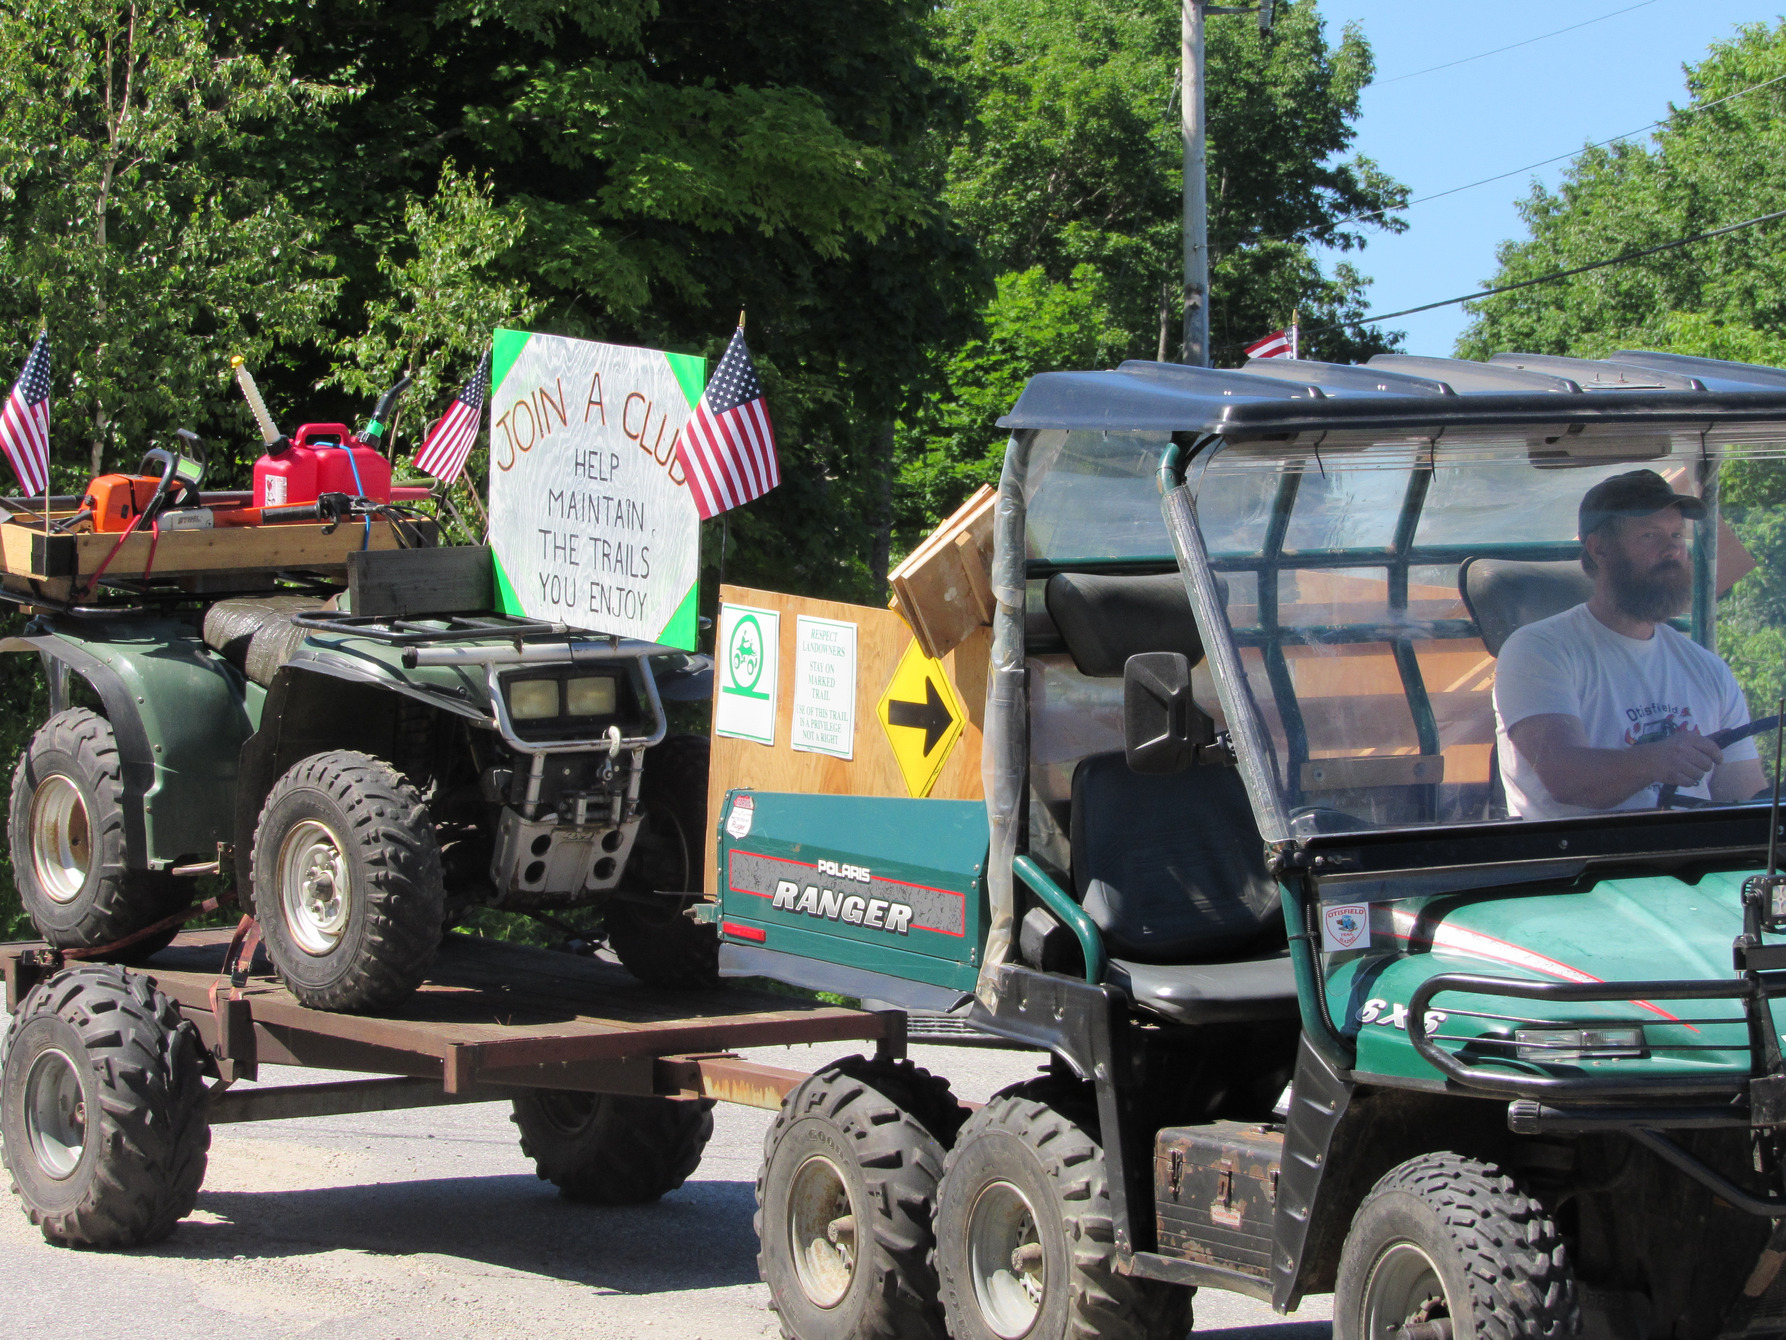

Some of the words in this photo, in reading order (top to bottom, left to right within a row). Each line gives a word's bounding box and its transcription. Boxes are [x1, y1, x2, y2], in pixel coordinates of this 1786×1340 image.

[496, 377, 568, 472] JOIN
[584, 372, 606, 426] A
[574, 448, 620, 483] HELP
[548, 488, 645, 533] MAINTAIN
[538, 529, 580, 566] THE
[589, 537, 650, 580] TRAILS
[539, 572, 577, 608] YOU
[589, 581, 647, 622] ENJOY
[810, 628, 838, 642] RESPECT
[802, 641, 845, 657] LANDOWNERS
[809, 661, 824, 673] STAY
[825, 663, 835, 674] ON
[808, 674, 835, 688] MARKED
[811, 688, 830, 701] TRAIL
[806, 706, 814, 716] OF
[815, 707, 828, 719] THIS
[829, 710, 848, 721] TRAIL
[1626, 703, 1678, 721] Otisfield
[810, 719, 842, 733] PRIVILEGE
[802, 730, 815, 741] NOT
[820, 733, 839, 744] RIGHT
[817, 859, 871, 883] POLARIS
[771, 879, 914, 936] RANGER
[1327, 909, 1364, 918] OTISFIELD
